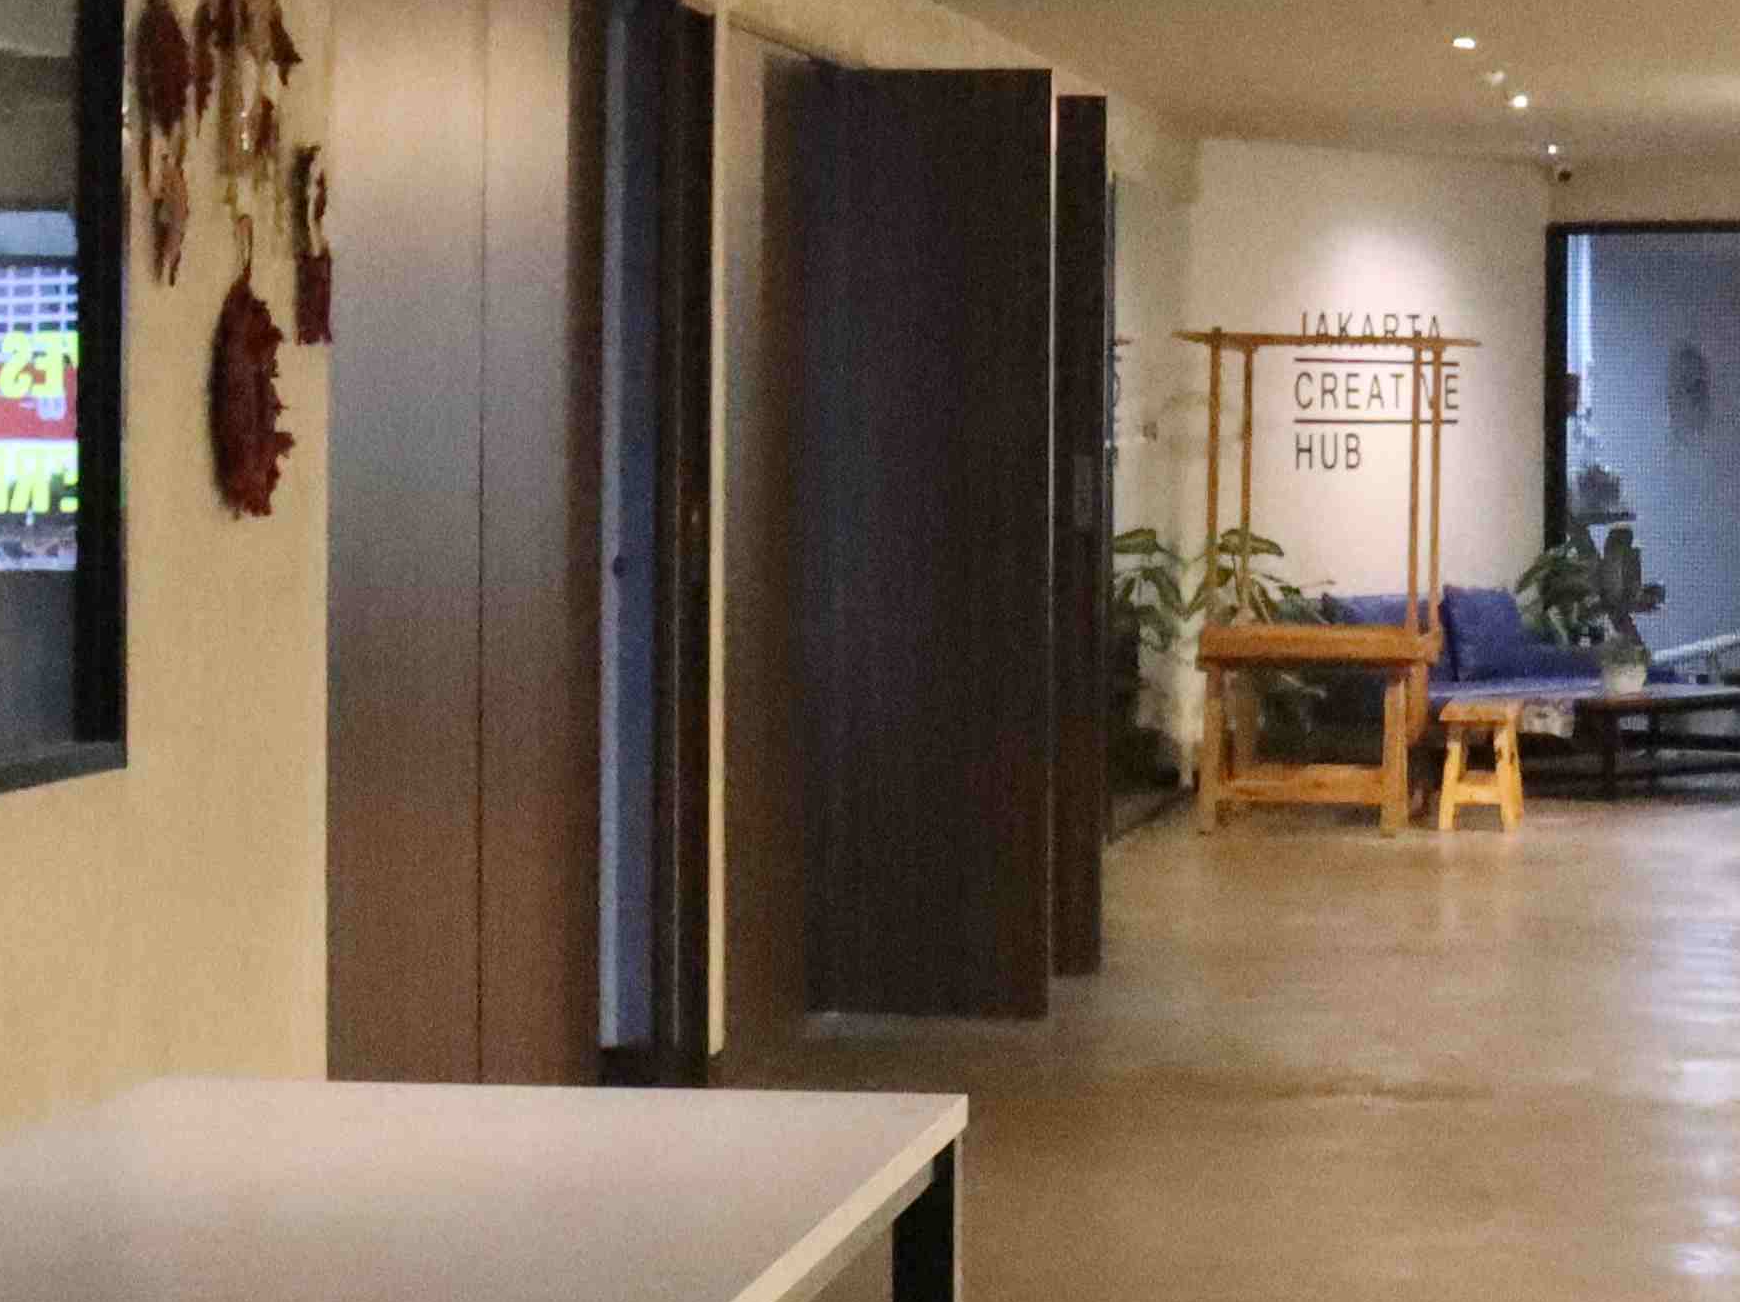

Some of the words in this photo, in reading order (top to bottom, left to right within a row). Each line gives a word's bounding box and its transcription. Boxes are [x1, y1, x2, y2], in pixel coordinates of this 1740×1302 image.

[1298, 311, 1447, 349] JAKARTA
[1294, 371, 1459, 410] CREATVE
[1294, 432, 1361, 471] HUB
